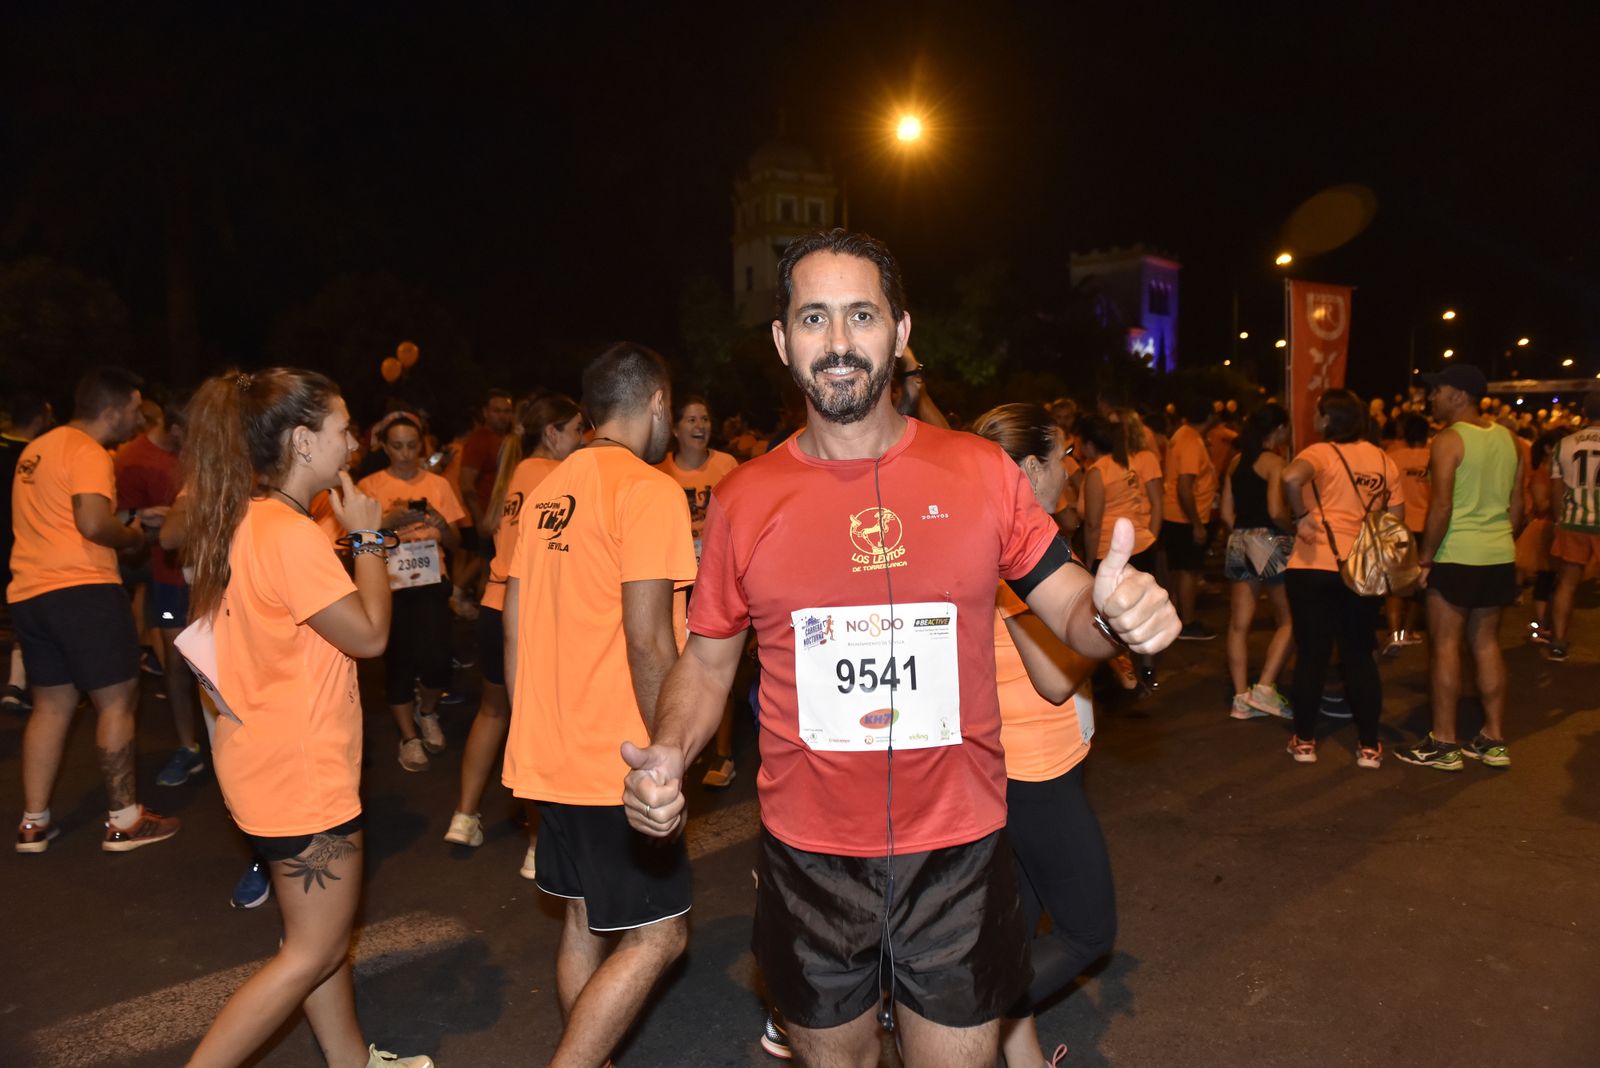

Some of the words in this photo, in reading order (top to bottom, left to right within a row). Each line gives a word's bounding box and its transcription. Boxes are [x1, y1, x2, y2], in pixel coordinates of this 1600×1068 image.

[398, 556, 430, 571] 23089
[851, 552, 870, 565] LOS
[836, 655, 917, 694] 9541
